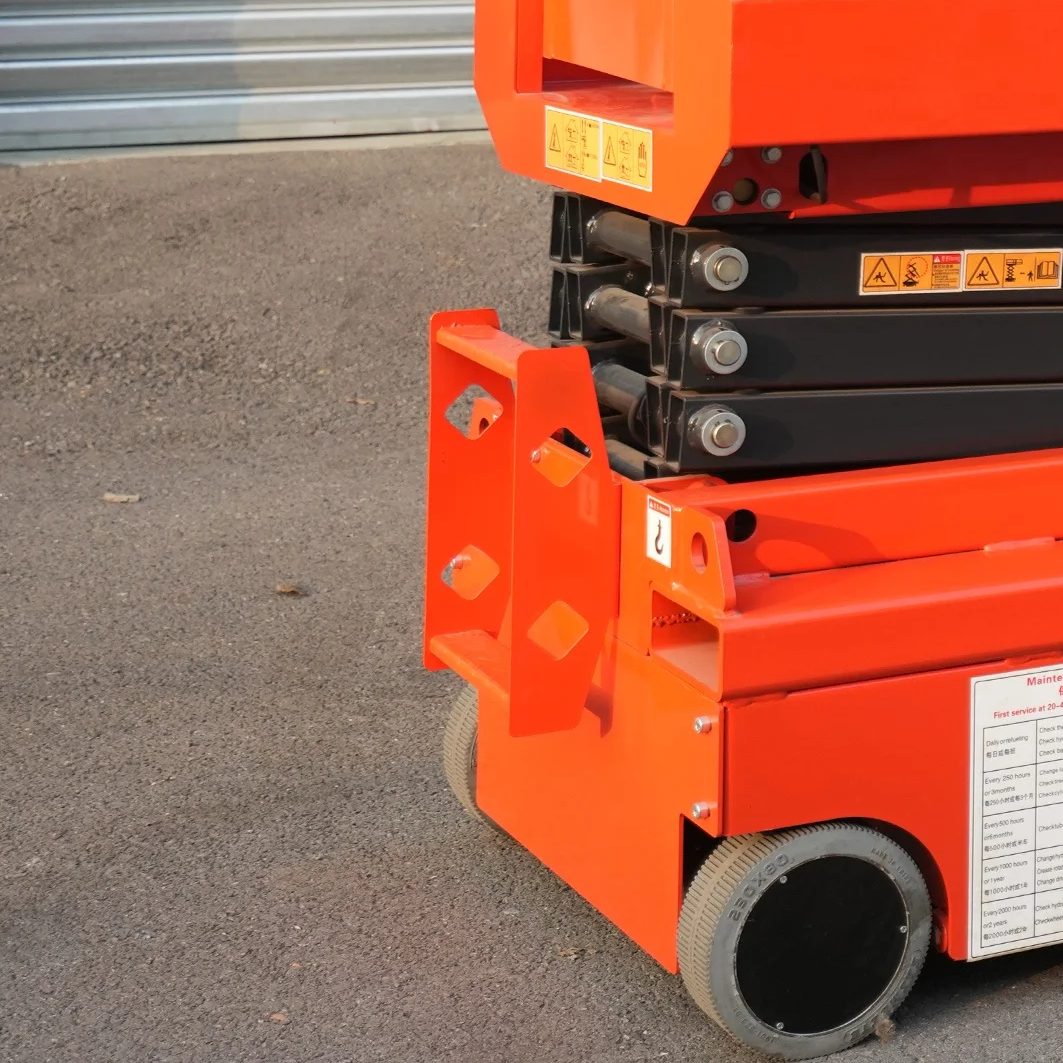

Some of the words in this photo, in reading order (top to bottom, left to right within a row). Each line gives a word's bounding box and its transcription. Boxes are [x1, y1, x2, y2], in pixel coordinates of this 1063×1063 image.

[993, 710, 1009, 719] First
[1011, 706, 1036, 716] service
[1039, 768, 1058, 776] Change
[984, 776, 1001, 785] Every
[1037, 878, 1055, 887] Change
